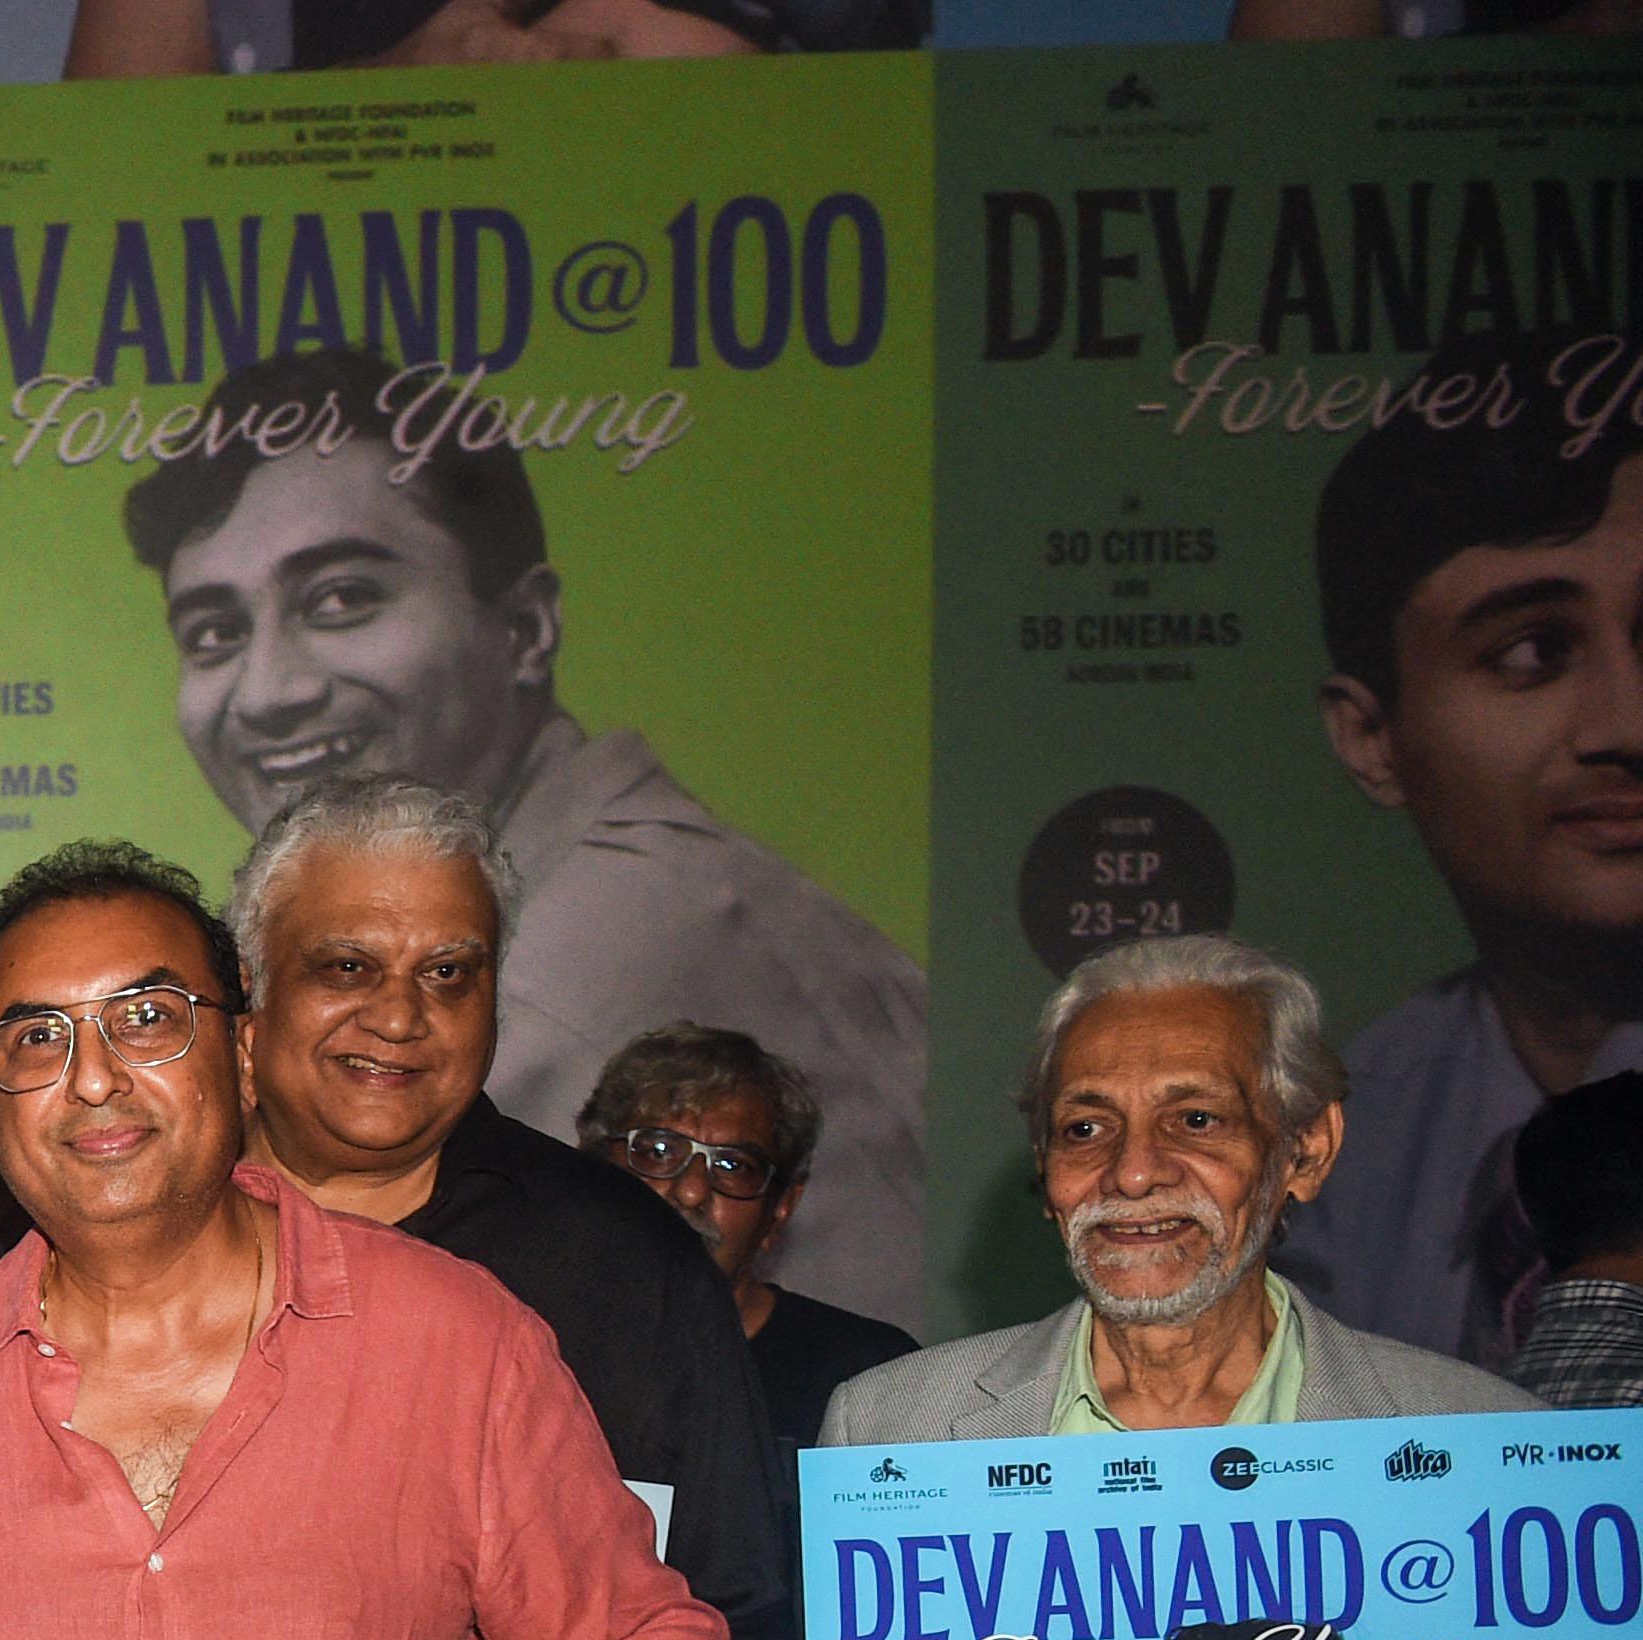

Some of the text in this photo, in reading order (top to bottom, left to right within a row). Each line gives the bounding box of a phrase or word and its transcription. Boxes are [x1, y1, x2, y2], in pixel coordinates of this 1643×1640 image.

[91, 207, 533, 387] ANAND
[552, 240, 648, 335] @
[663, 192, 887, 371] 100
[981, 185, 1234, 362] DEV
[378, 361, 693, 484] Young
[1046, 528, 1215, 565] 30 CITIES
[1020, 612, 1242, 652] 58 CINEMAS
[1094, 853, 1161, 886] SEP
[833, 1488, 948, 1503] FILM HERITAGE
[987, 1461, 1052, 1490] NFDC
[1381, 1539, 1456, 1604] @
[1466, 1503, 1643, 1629] 100
